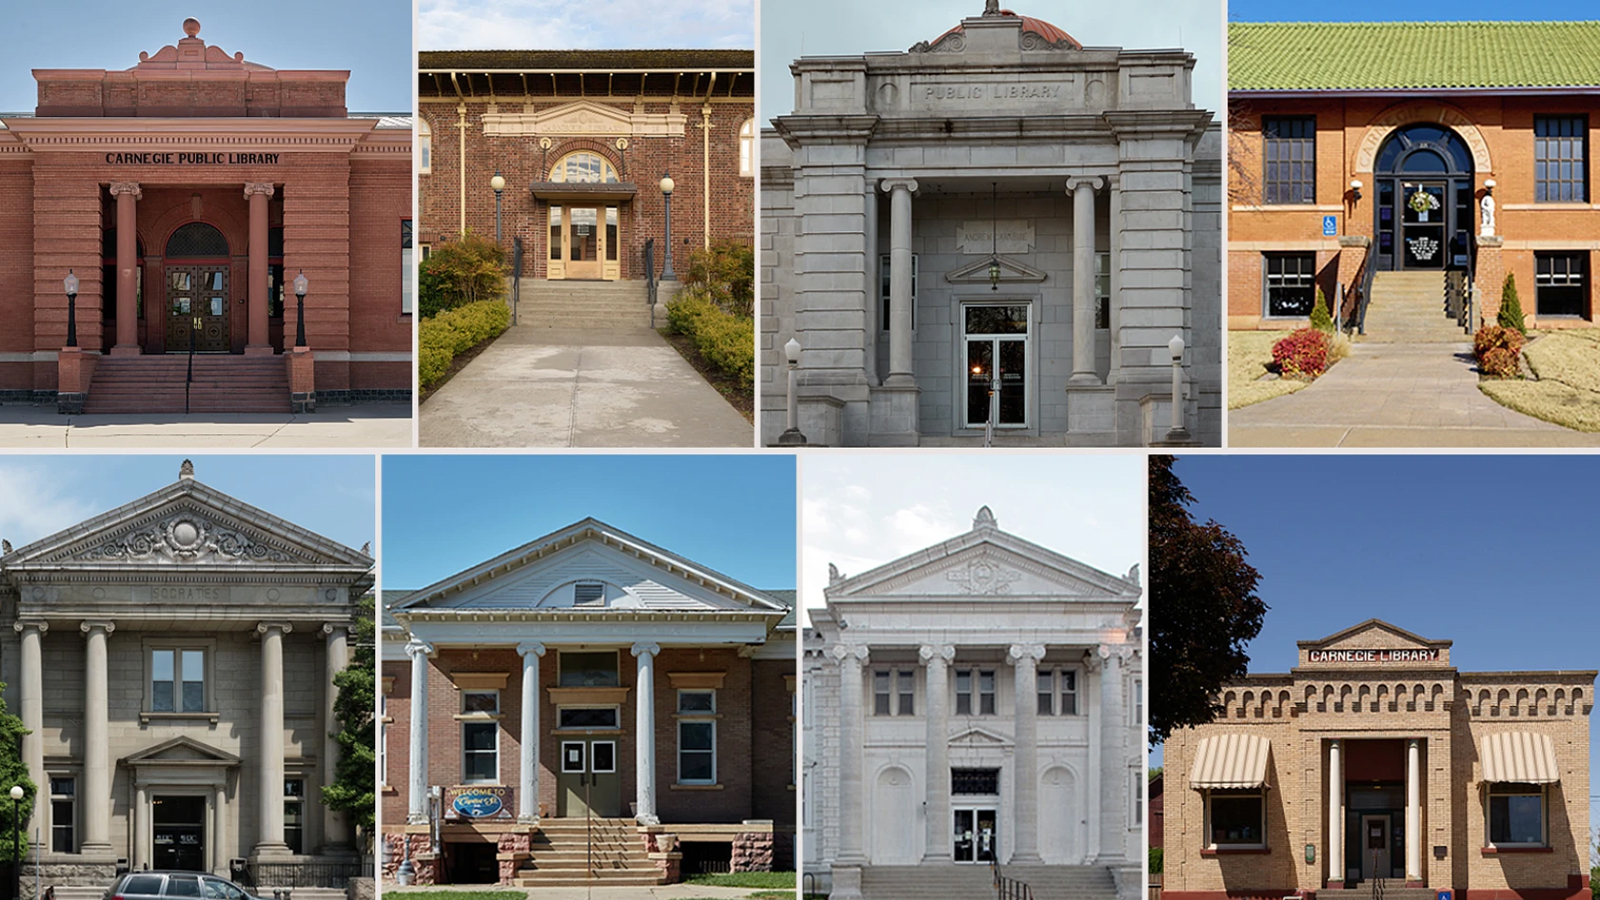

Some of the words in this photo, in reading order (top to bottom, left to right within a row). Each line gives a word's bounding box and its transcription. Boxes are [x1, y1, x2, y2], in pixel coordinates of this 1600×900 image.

[925, 87, 982, 99] PUBLIC
[994, 85, 1060, 98] LIBRARY
[1359, 105, 1426, 167] CARNEGIE
[1440, 107, 1489, 170] LIBRARY
[105, 152, 174, 164] CARNEGIE
[179, 153, 224, 164] PUBLIC
[228, 153, 280, 164] LIBRARY
[153, 587, 219, 599] SOCRATES
[1380, 650, 1437, 661] LIBRARY
[450, 788, 492, 796] WELCOME
[494, 788, 505, 796] TO
